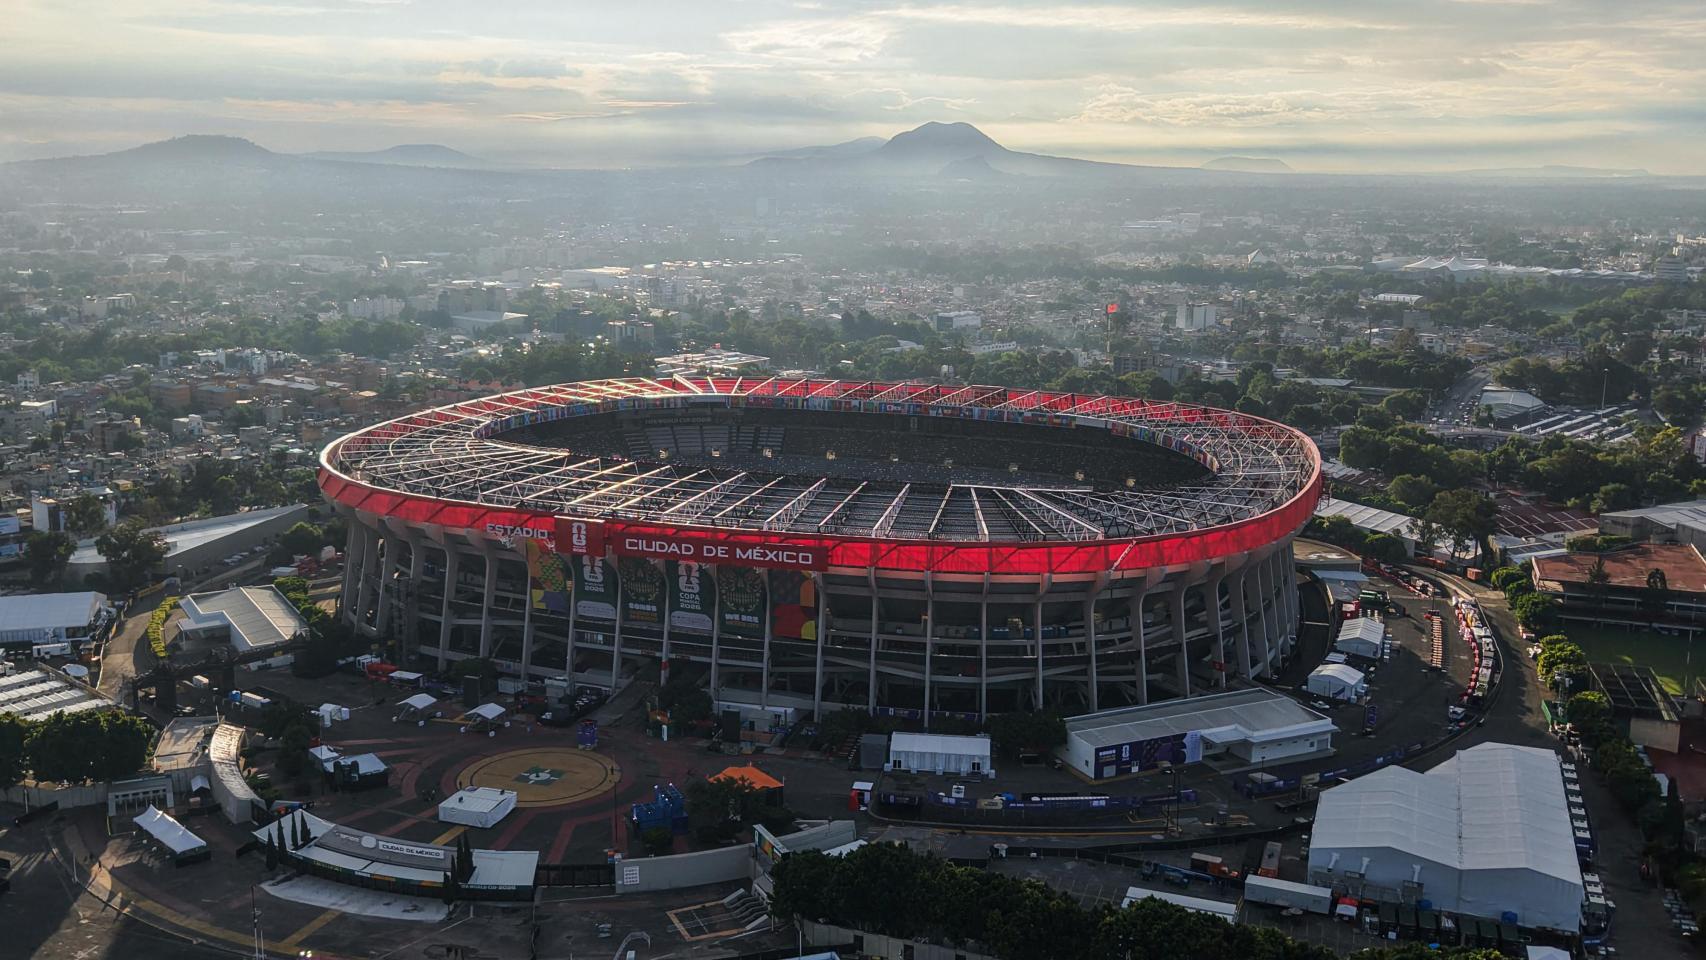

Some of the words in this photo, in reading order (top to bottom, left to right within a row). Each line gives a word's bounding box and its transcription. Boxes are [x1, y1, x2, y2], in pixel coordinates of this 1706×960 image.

[486, 523, 548, 539] ESTADIO
[625, 538, 694, 555] CIUDAD
[703, 545, 728, 558] DE
[736, 547, 812, 564] MÉXICO
[680, 592, 700, 600] COPA
[382, 844, 405, 852] CIUDAD
[416, 849, 440, 857] MÉXICO
